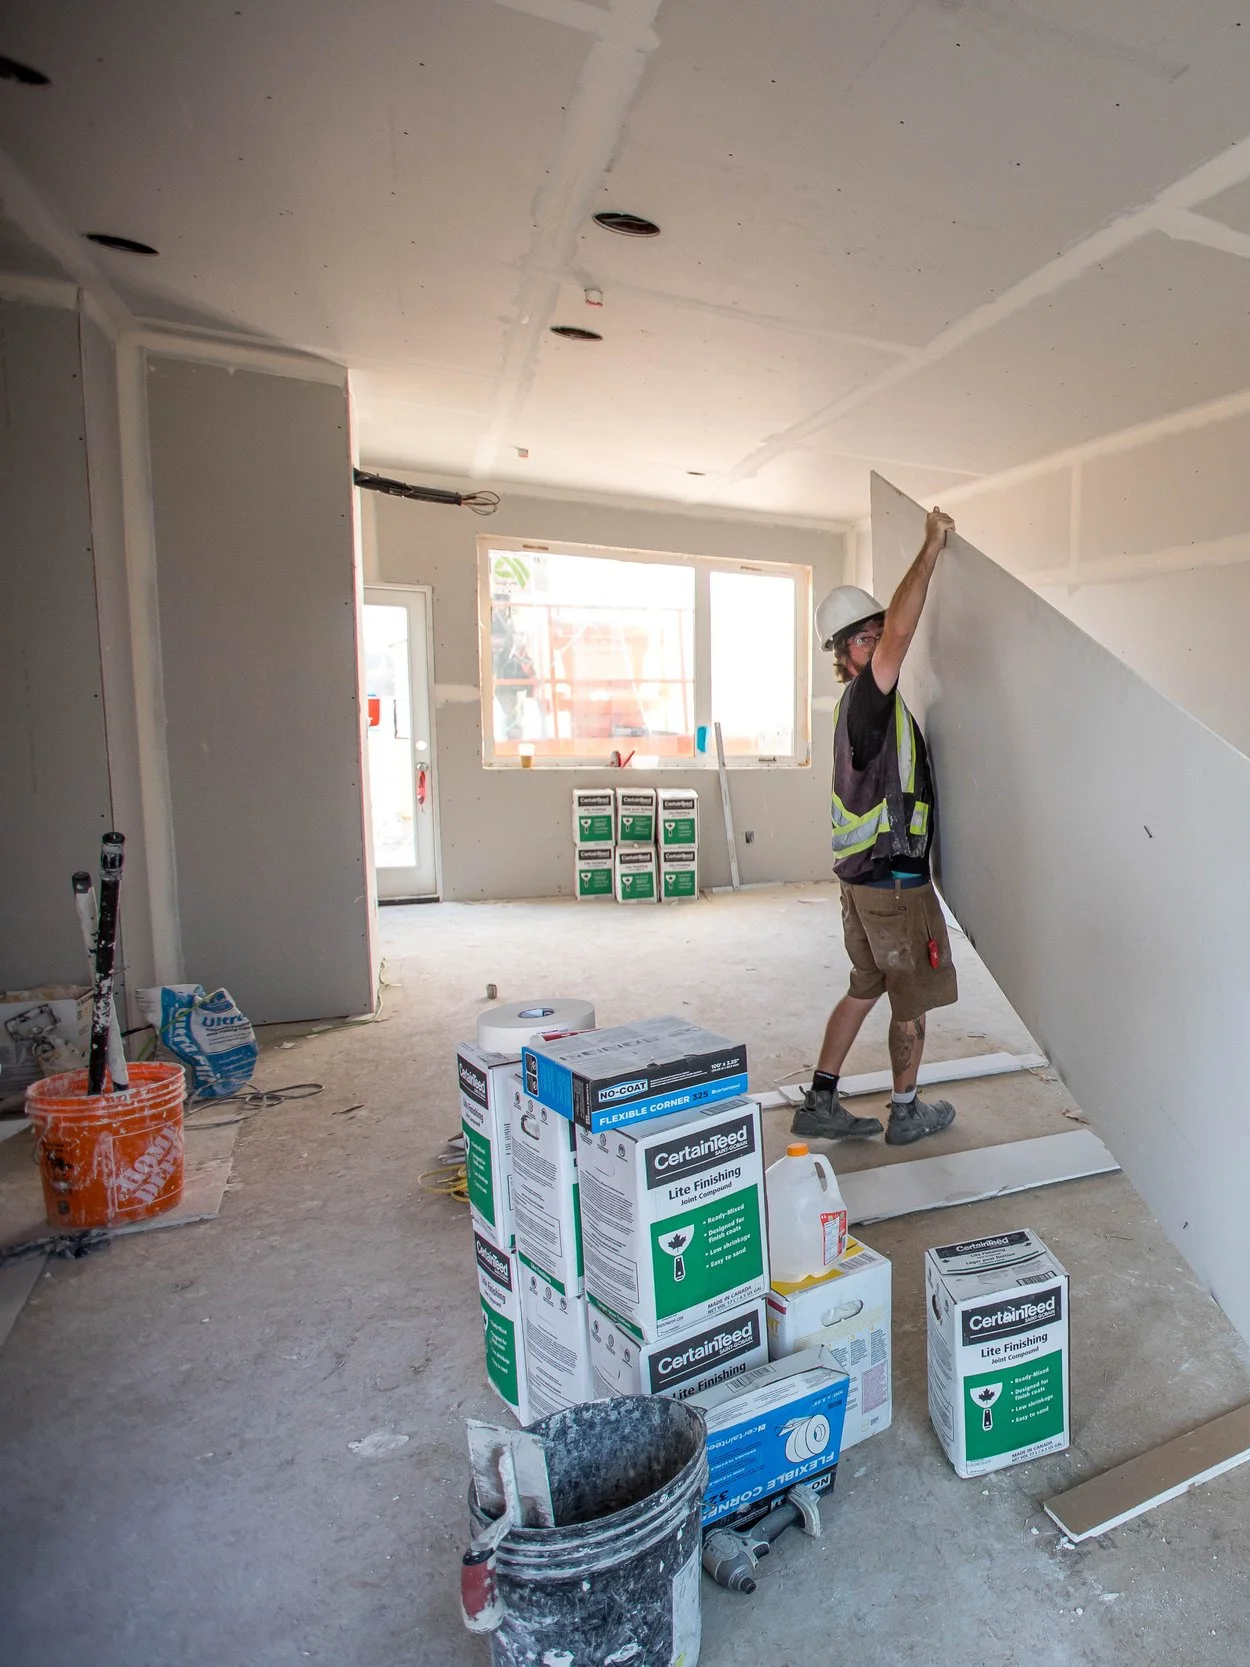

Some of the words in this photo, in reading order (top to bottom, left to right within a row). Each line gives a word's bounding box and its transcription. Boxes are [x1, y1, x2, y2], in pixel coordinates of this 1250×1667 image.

[600, 1081, 647, 1100] NO-COAT
[600, 1106, 647, 1126] FLEXIBLE
[650, 1095, 690, 1111] CORNER
[692, 1090, 709, 1101] 325
[654, 1125, 748, 1170] CertainTeed
[668, 1186, 691, 1201] Lite
[694, 1166, 741, 1192] Finishing
[681, 1195, 697, 1206] Joint
[699, 1181, 732, 1199] Compound
[707, 1203, 745, 1224] Ready-Mixed
[708, 1220, 735, 1236] Designed
[709, 1246, 722, 1256] Low
[723, 1233, 751, 1249] shrinkage
[710, 1258, 724, 1269] Easy
[732, 1246, 746, 1258] sand
[969, 1296, 1055, 1331] CertainTeed
[658, 1321, 753, 1375] CertainTeed
[981, 1346, 1001, 1358] Lite
[1004, 1332, 1048, 1353] Finishing
[991, 1355, 1007, 1365] Joint
[1008, 1346, 1040, 1362] Compound
[698, 1362, 746, 1393] Finishing
[1015, 1367, 1050, 1384] Ready-Mixed
[1015, 1382, 1040, 1396] Designed
[1015, 1403, 1027, 1412] Low
[1028, 1394, 1054, 1407] shrinkage
[1015, 1414, 1028, 1423] Easy
[1036, 1406, 1049, 1415] sand
[767, 1451, 835, 1490] FLEXIBLE
